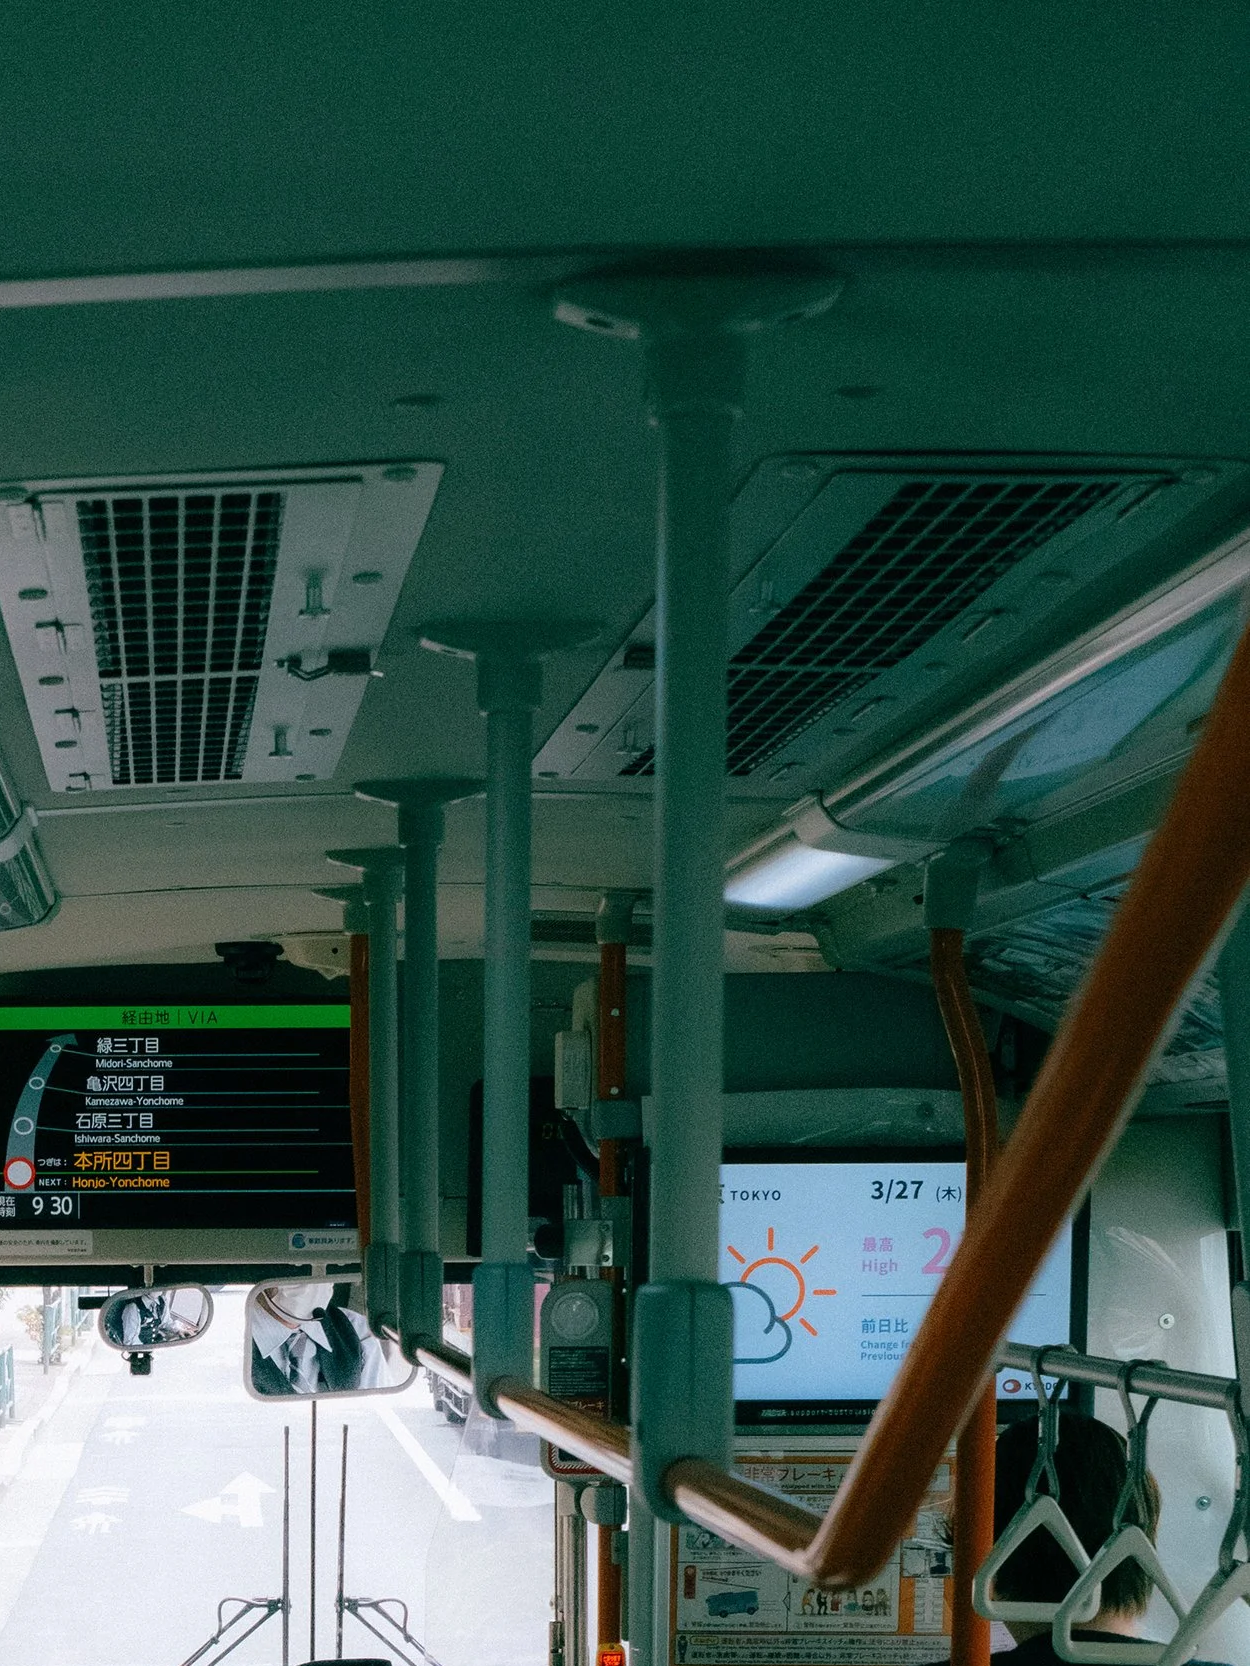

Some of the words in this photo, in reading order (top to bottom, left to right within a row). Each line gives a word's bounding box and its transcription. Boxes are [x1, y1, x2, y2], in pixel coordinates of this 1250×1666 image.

[121, 1010, 169, 1025] 経由地
[188, 1011, 218, 1024] VIA
[96, 1037, 159, 1054] 緑三丁目
[95, 1058, 173, 1069] Midori-Sanchome
[86, 1075, 164, 1091] 亀沢四丁目
[85, 1096, 184, 1107] Kamezawa-Yonchome
[75, 1113, 154, 1129] 石原三丁目
[74, 1133, 161, 1144] Ishiwara-Sanchome
[73, 1151, 170, 1170] 本所四丁目
[72, 1175, 170, 1189] Honjo-Yonchome
[729, 1190, 782, 1202] TOKYO
[871, 1180, 923, 1203] 3/27
[935, 1186, 962, 1204] (木)
[862, 1237, 893, 1252] 最高
[862, 1258, 898, 1275] High
[861, 1318, 908, 1334] 前日比
[860, 1340, 899, 1352] Change
